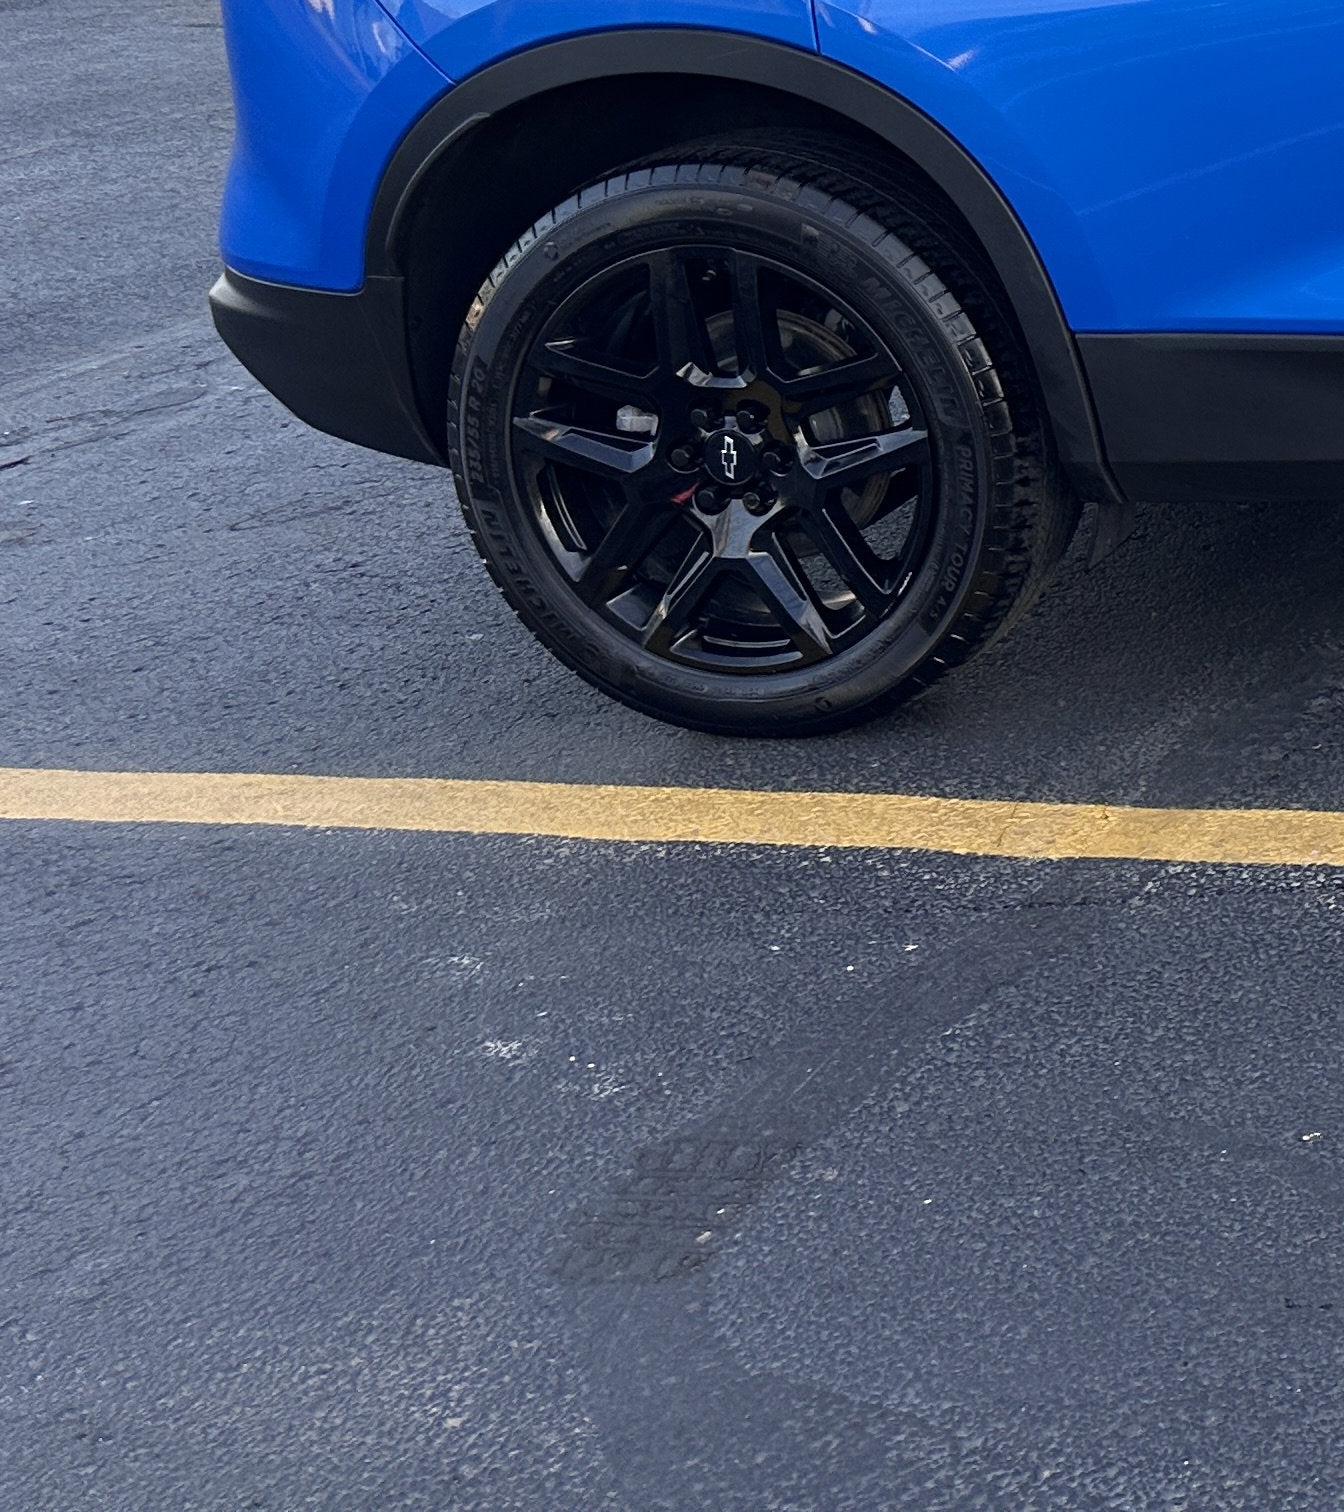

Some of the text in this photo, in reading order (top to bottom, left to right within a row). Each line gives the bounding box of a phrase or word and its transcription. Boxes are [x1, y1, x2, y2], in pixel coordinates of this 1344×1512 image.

[859, 278, 961, 417] MICHELIN
[466, 367, 486, 484] 235/55 R 20
[957, 446, 973, 536] PRIMACY
[482, 509, 578, 642] MICHELIN
[941, 543, 967, 592] TOUR
